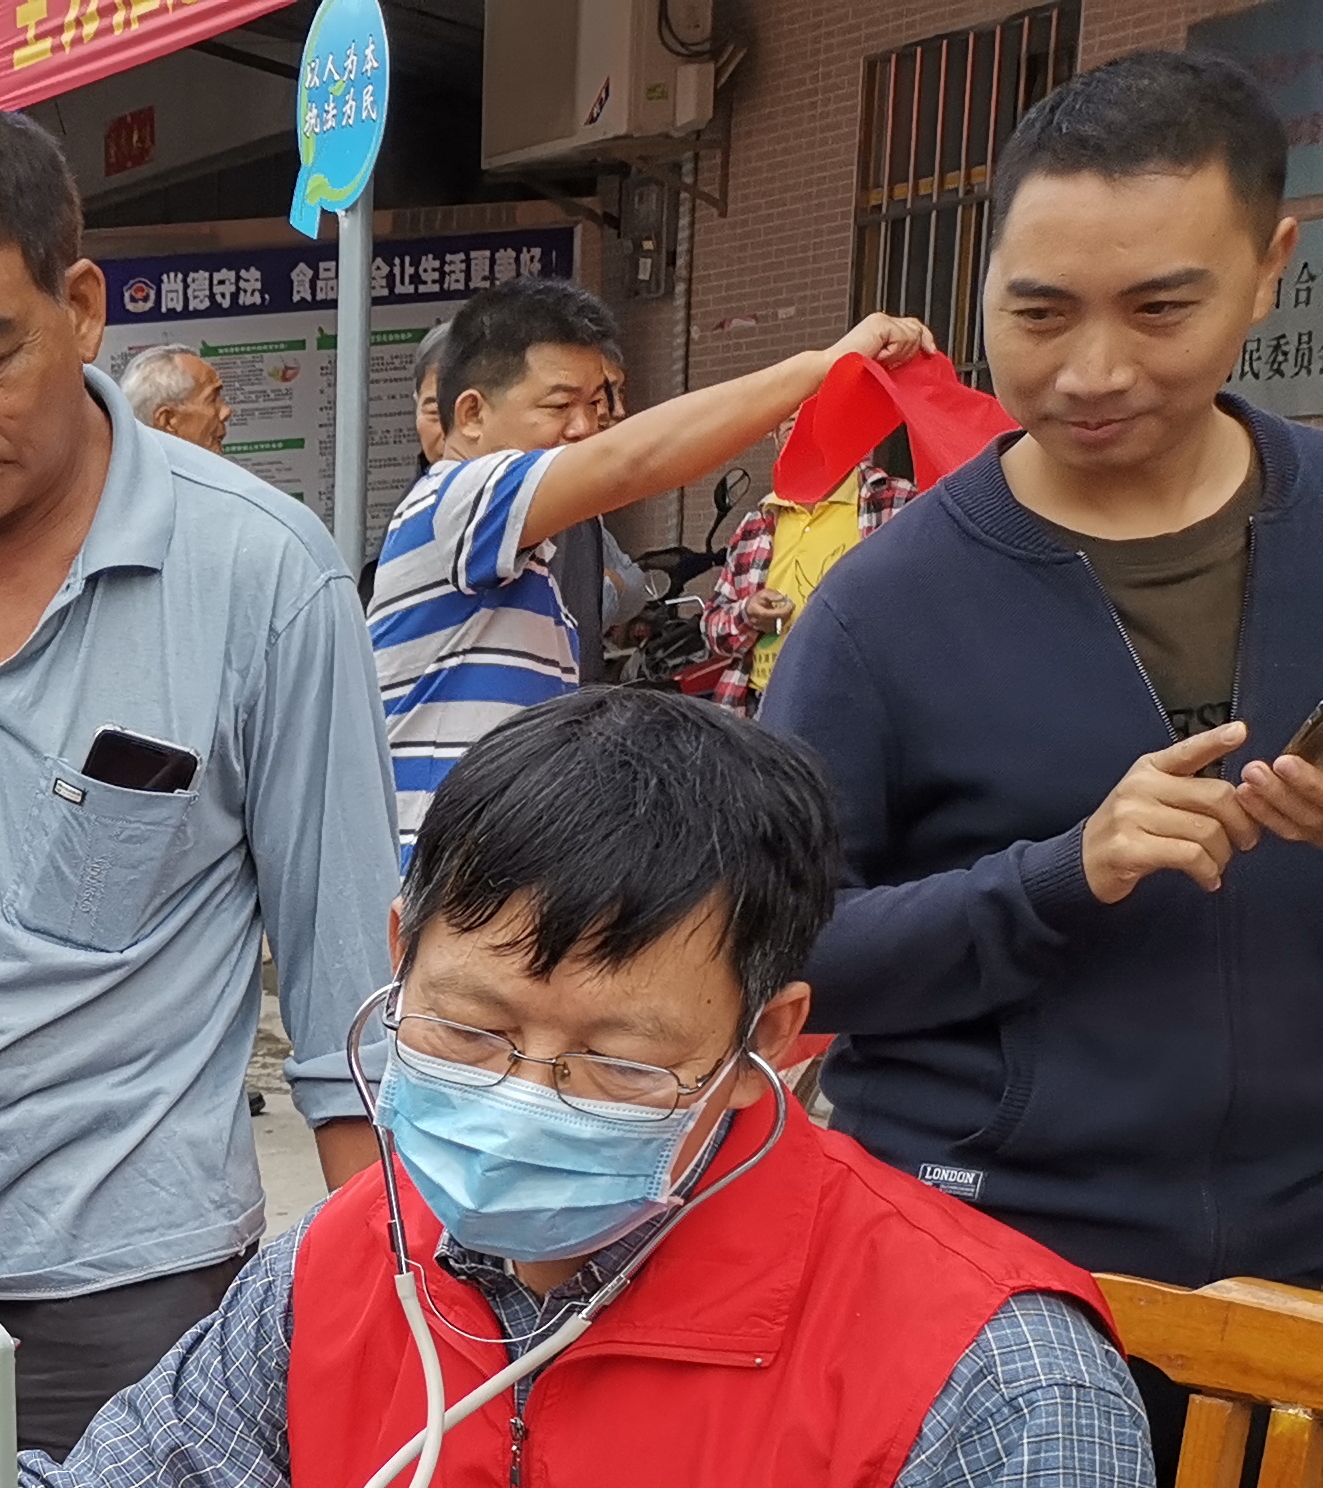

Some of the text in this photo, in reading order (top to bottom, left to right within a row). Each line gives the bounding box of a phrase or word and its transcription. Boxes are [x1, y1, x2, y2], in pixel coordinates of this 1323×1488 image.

[305, 34, 379, 89] 以人为本
[304, 84, 377, 137] 执法为民
[925, 1166, 976, 1184] LONDON
